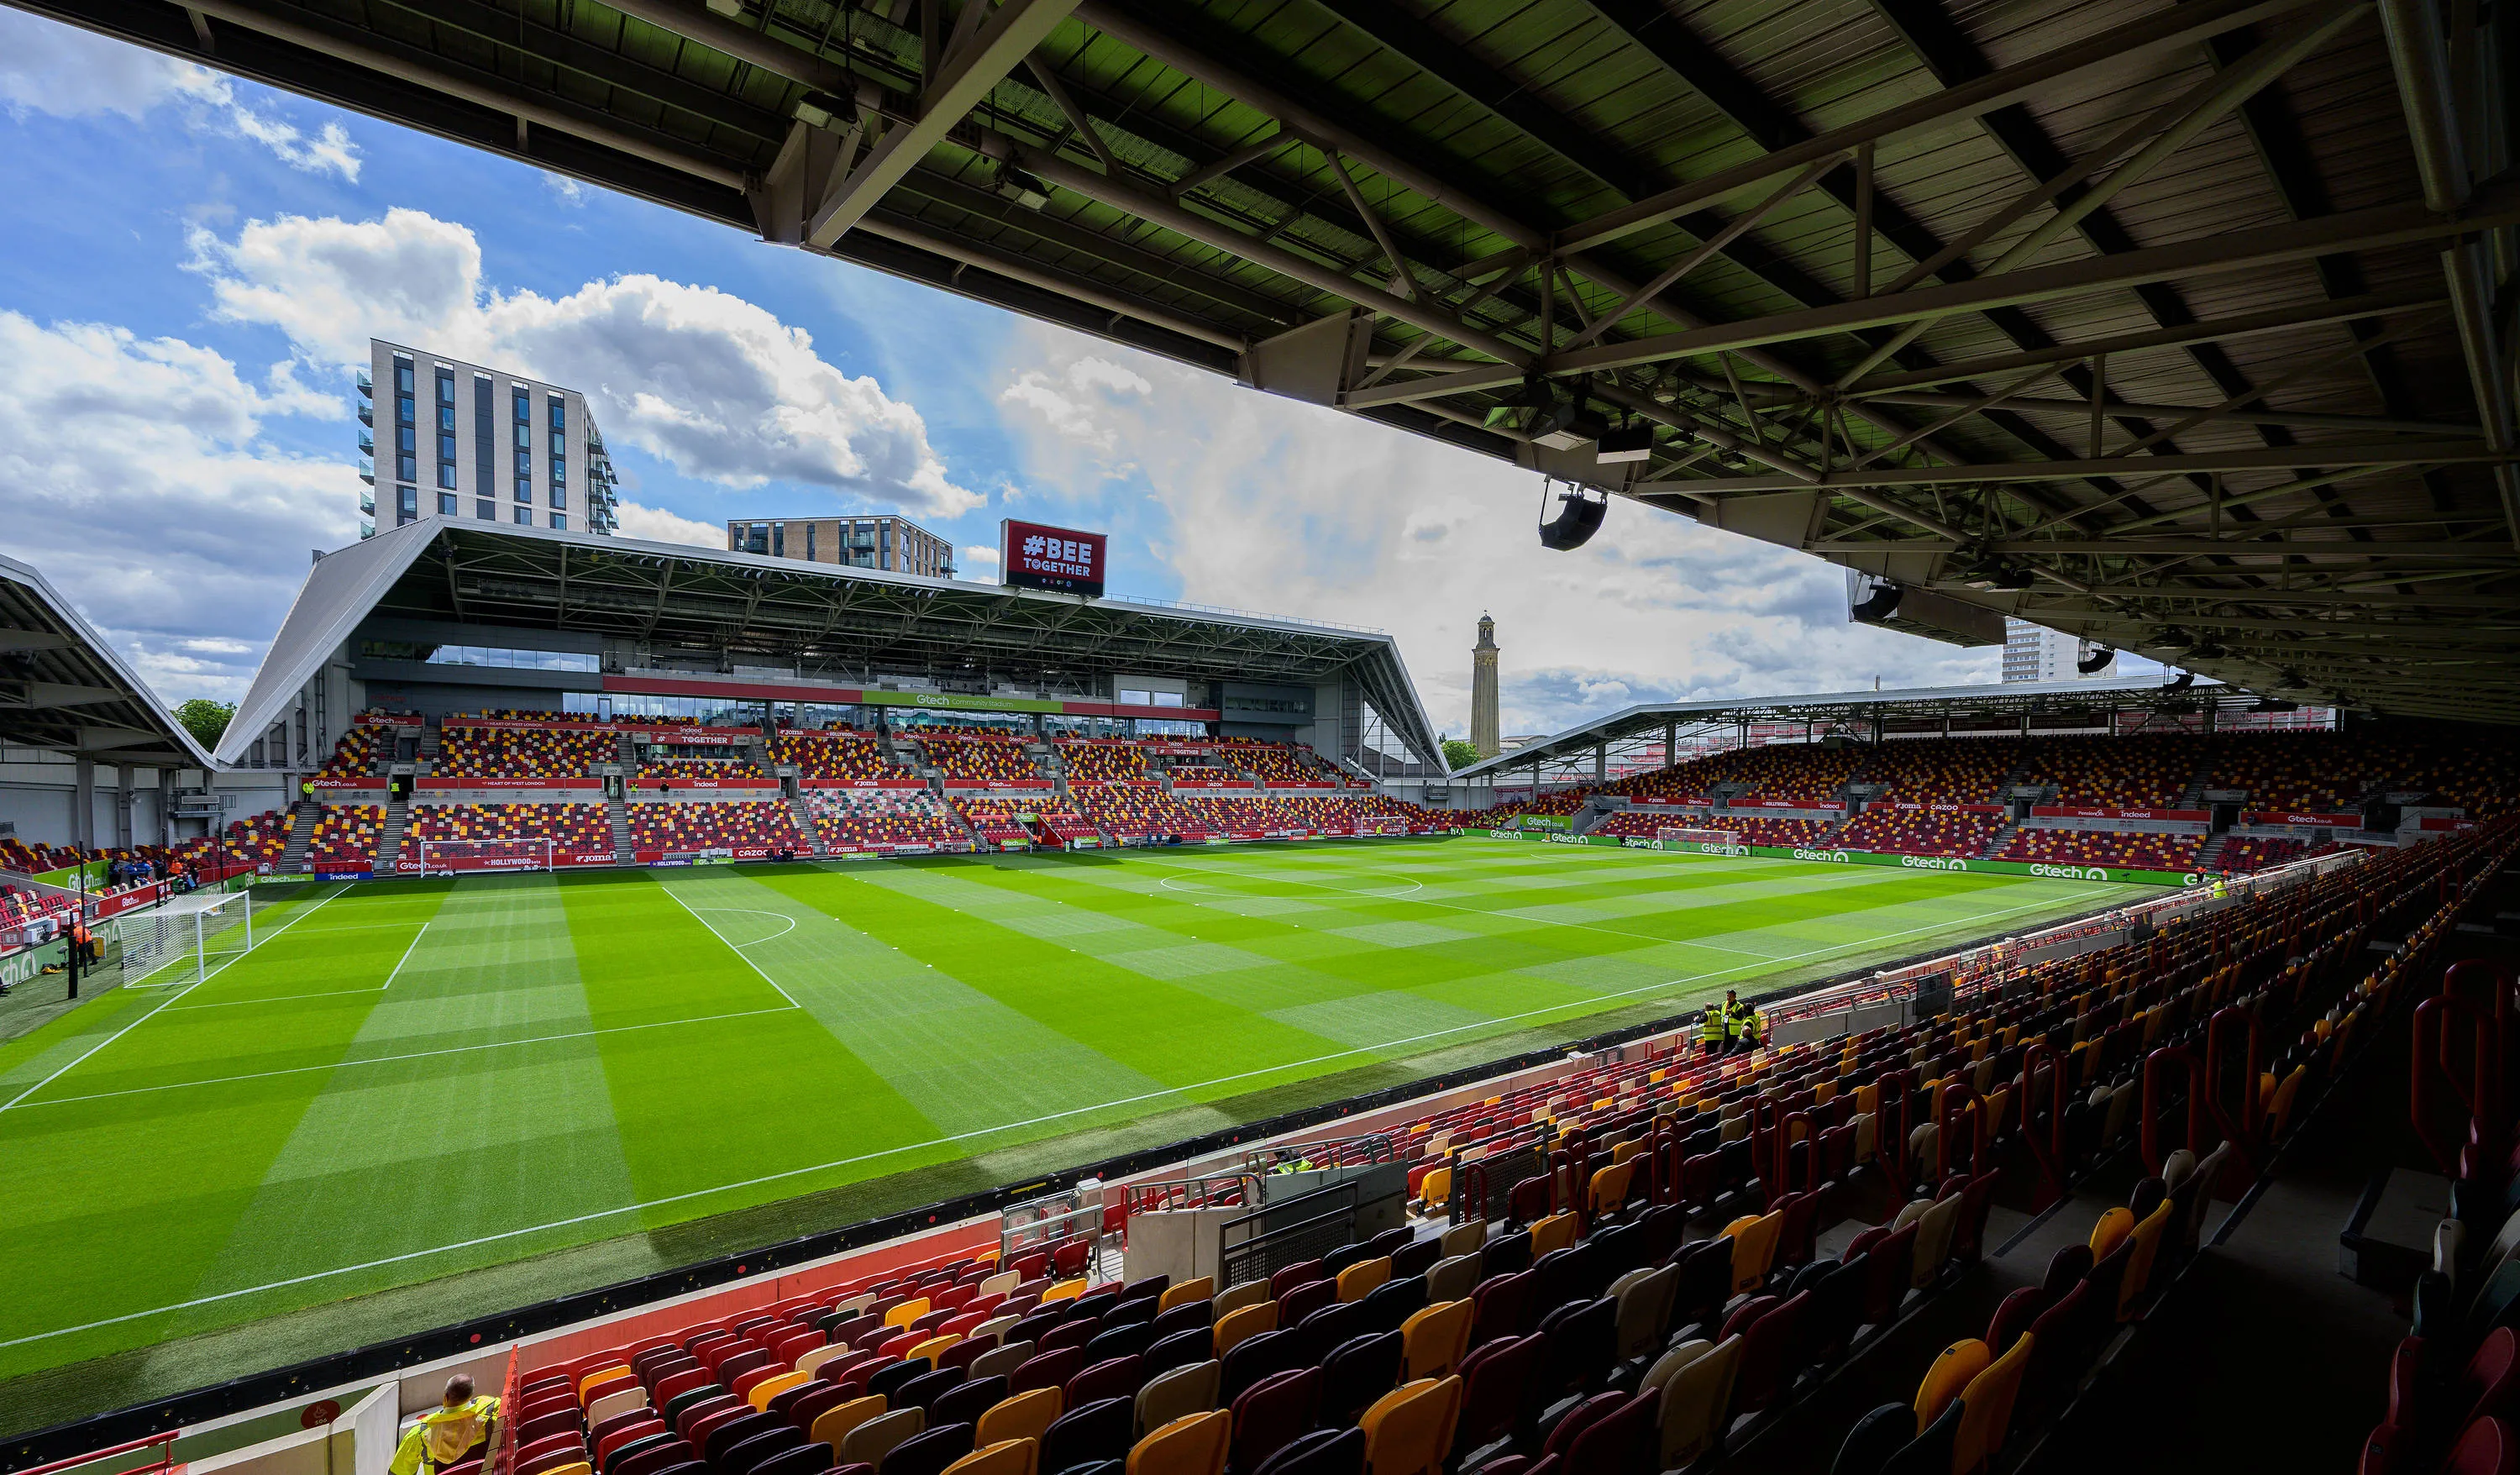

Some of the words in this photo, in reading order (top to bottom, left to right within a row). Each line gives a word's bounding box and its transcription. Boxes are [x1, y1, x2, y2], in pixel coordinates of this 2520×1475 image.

[1022, 535, 1092, 564] #BEE
[1023, 557, 1090, 577] TOGETHER
[916, 694, 949, 706] Gtech
[952, 698, 989, 707] Community
[989, 699, 1014, 708] Stadium
[2119, 810, 2150, 818] indeed
[2287, 815, 2333, 824] Gtech.co.uk
[1490, 830, 1513, 840] Gtech
[1551, 832, 1578, 844] Gtech
[1793, 848, 1831, 862] Gtech
[1901, 855, 1945, 869] Gtech
[2029, 863, 2082, 879] Gtech
